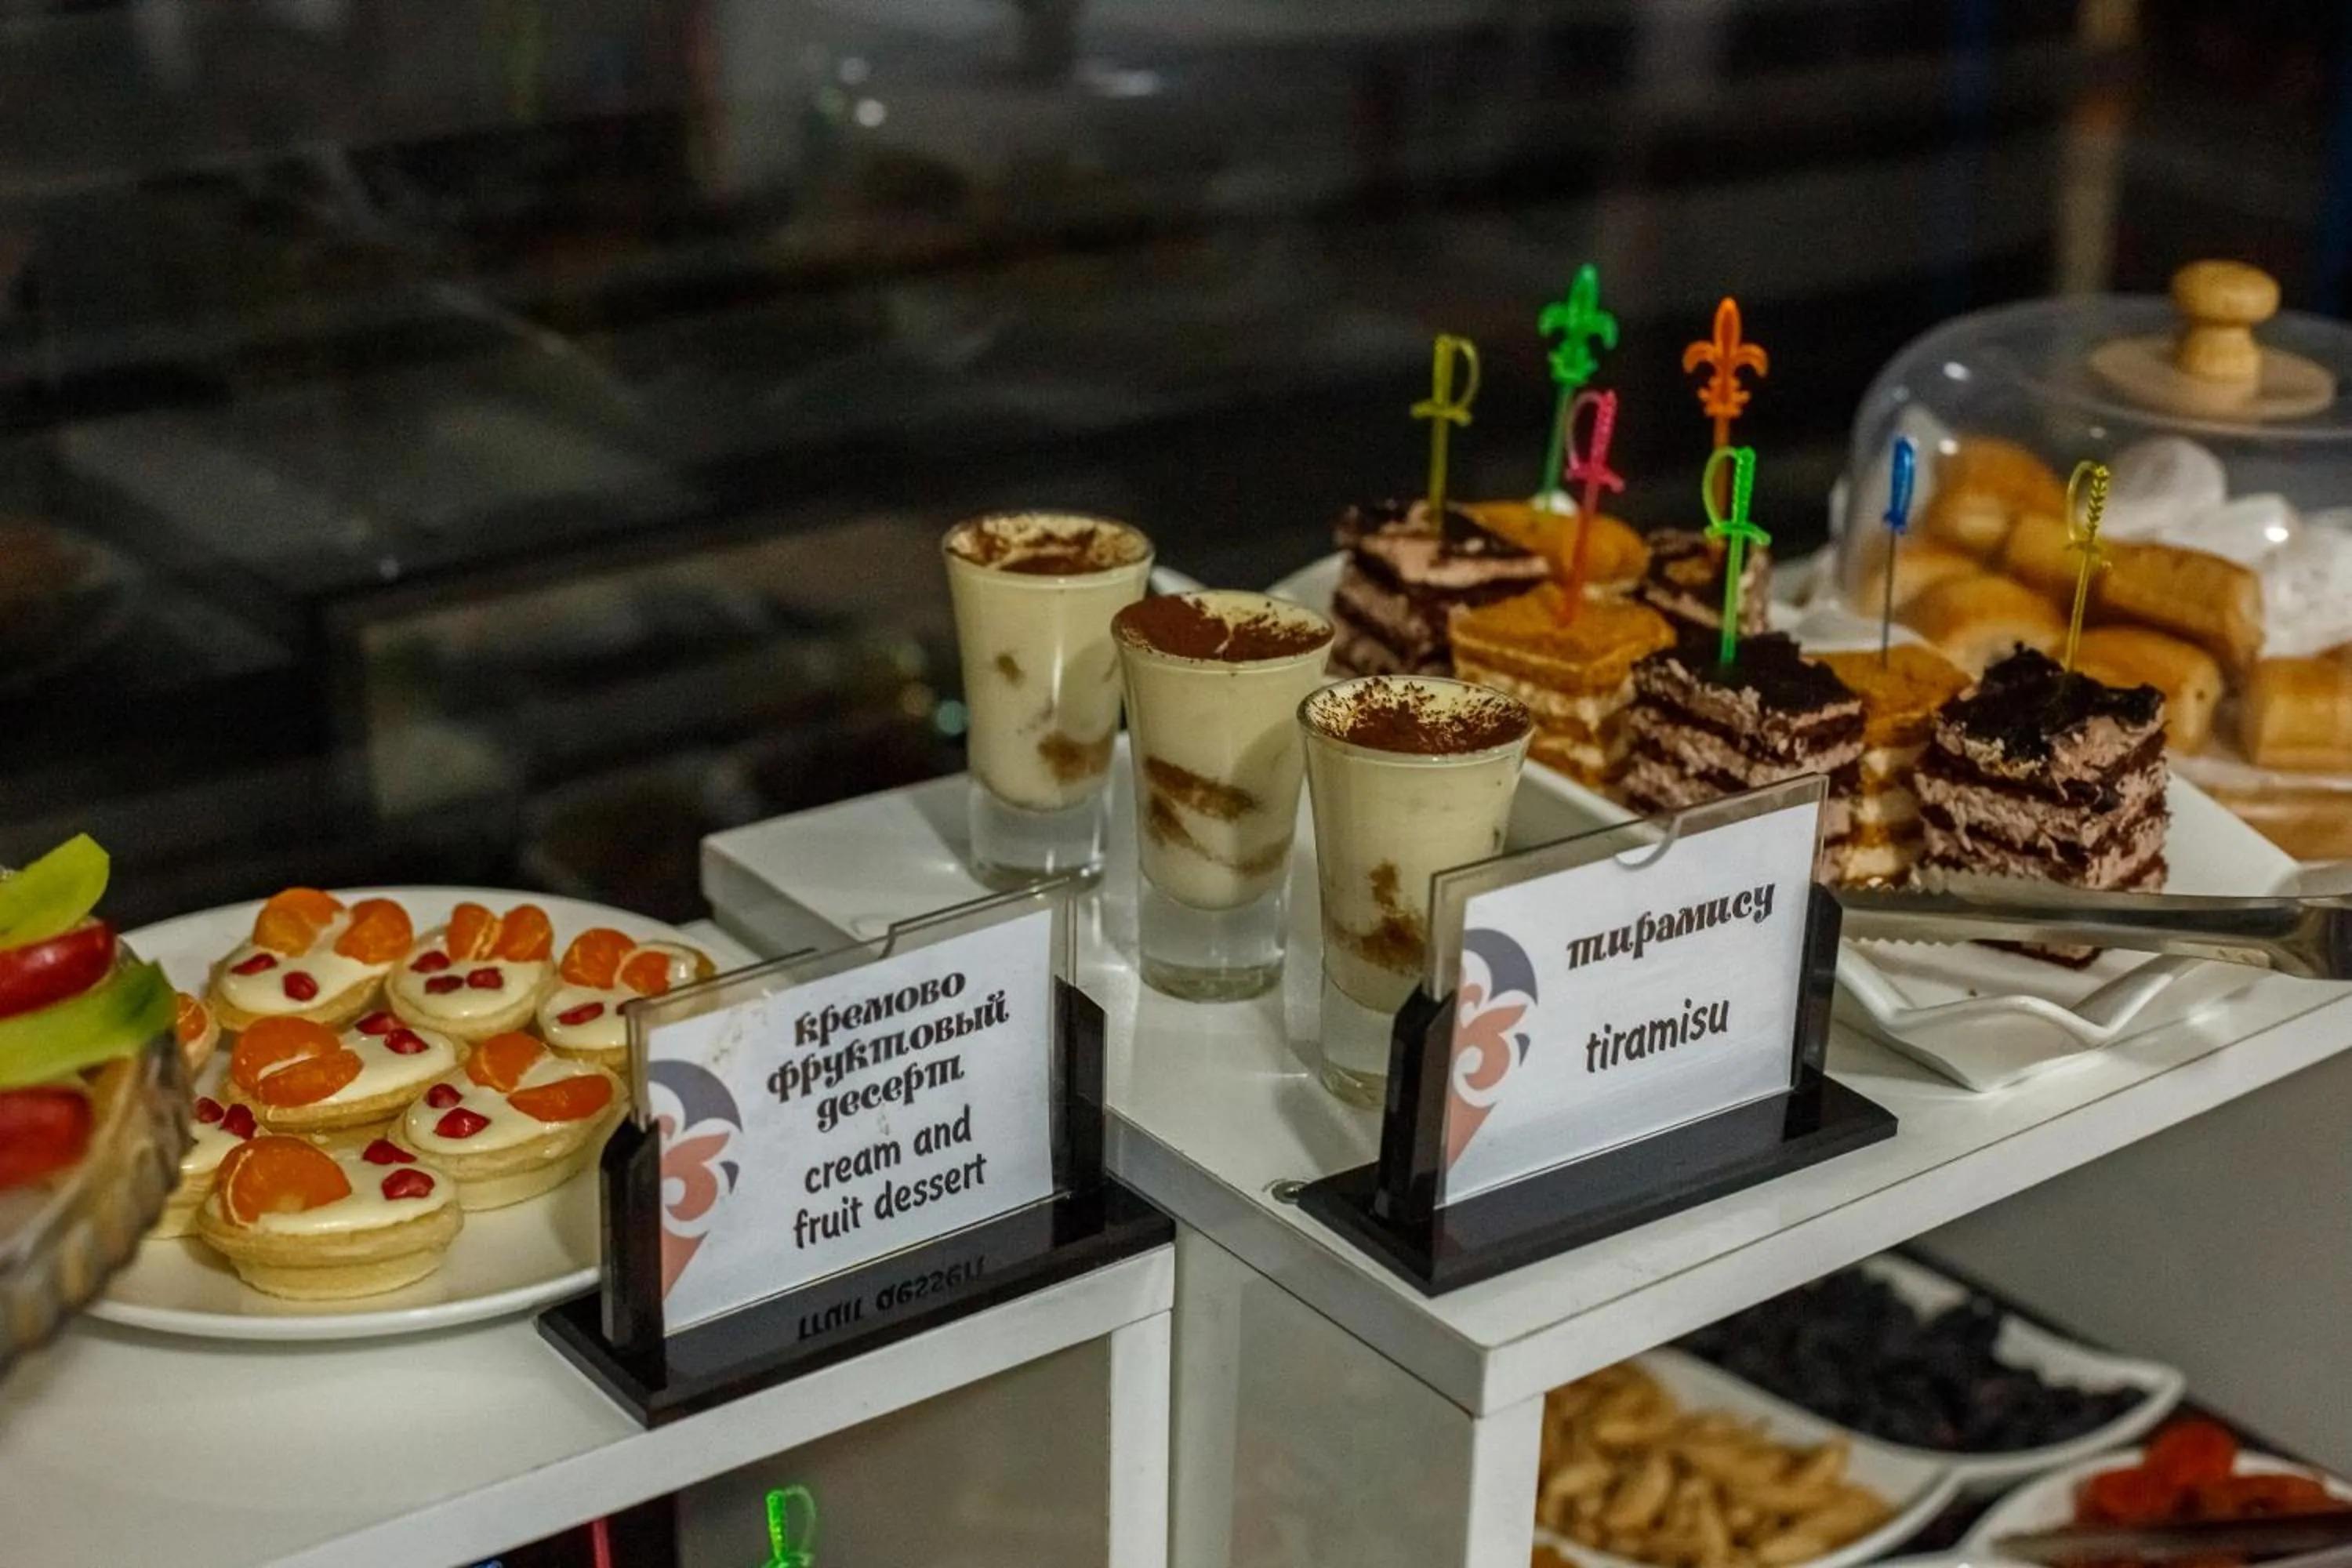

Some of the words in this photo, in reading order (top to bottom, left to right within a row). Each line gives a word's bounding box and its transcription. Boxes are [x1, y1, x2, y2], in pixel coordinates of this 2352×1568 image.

[1566, 883, 1777, 971] тирамису
[766, 989, 1011, 1104] фруктовый
[793, 971, 967, 1047] кремово
[1585, 997, 1730, 1074] tiramisu
[815, 1054, 966, 1134] десерт
[804, 1140, 902, 1195] cream
[913, 1102, 973, 1157] and
[792, 1195, 864, 1250] fruit
[873, 1152, 988, 1221] dessert
